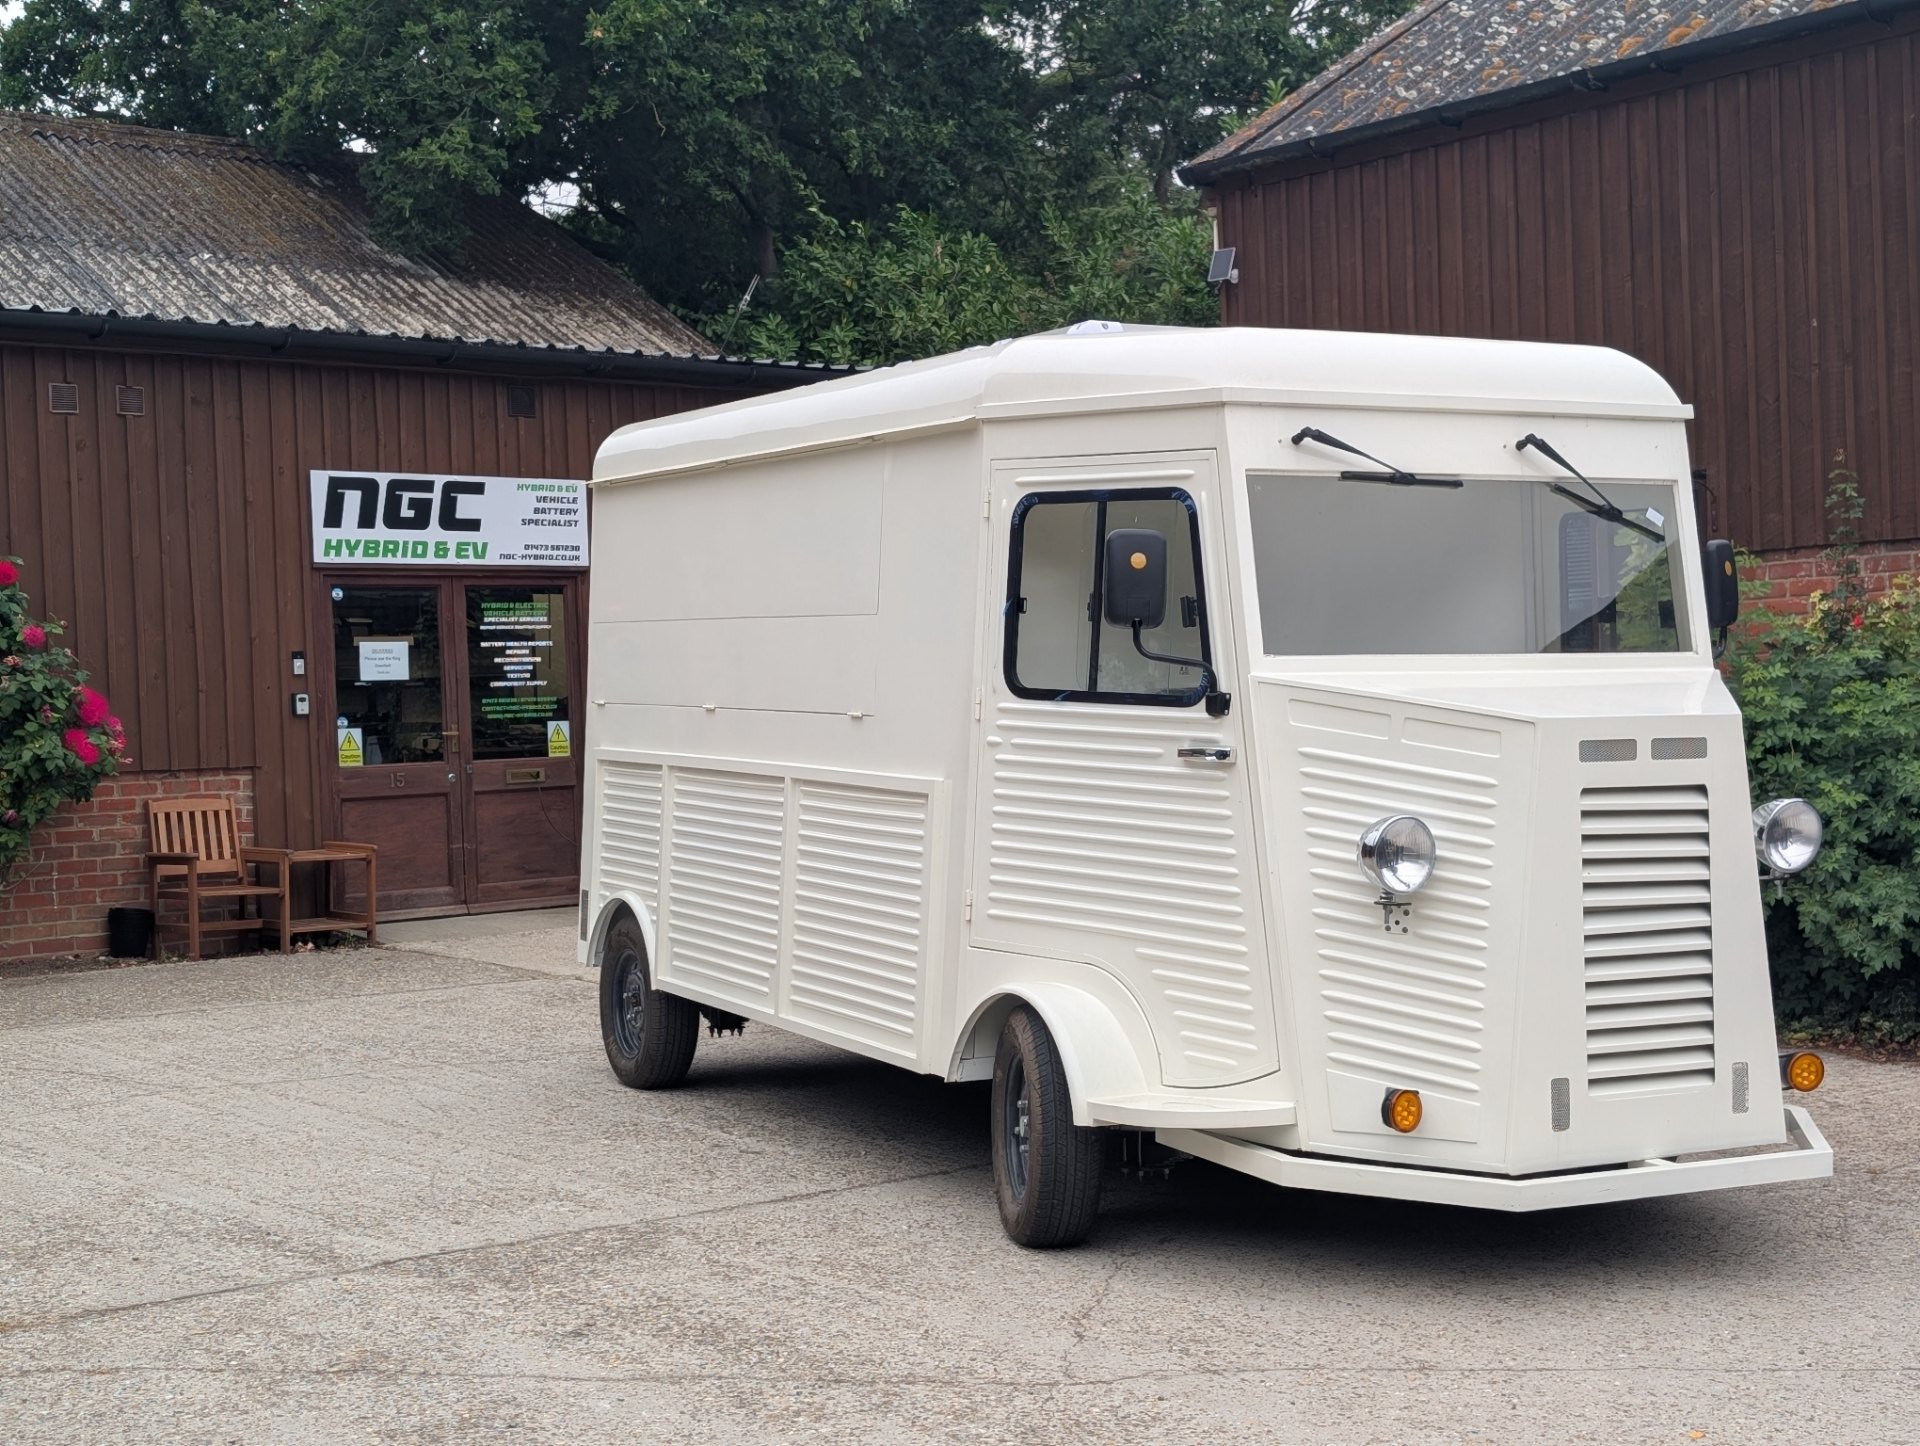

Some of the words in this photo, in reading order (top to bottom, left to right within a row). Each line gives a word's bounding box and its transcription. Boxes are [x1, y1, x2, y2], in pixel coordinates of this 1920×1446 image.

[516, 483, 556, 492] HYBRID
[565, 485, 578, 493] EV
[536, 495, 579, 504] VEHICLE
[533, 507, 579, 516] BATTERY
[521, 518, 580, 528] SPECIALIST
[323, 538, 429, 559] HYBRID
[433, 540, 450, 559] &
[455, 541, 489, 560] EV
[389, 772, 406, 788] 15
